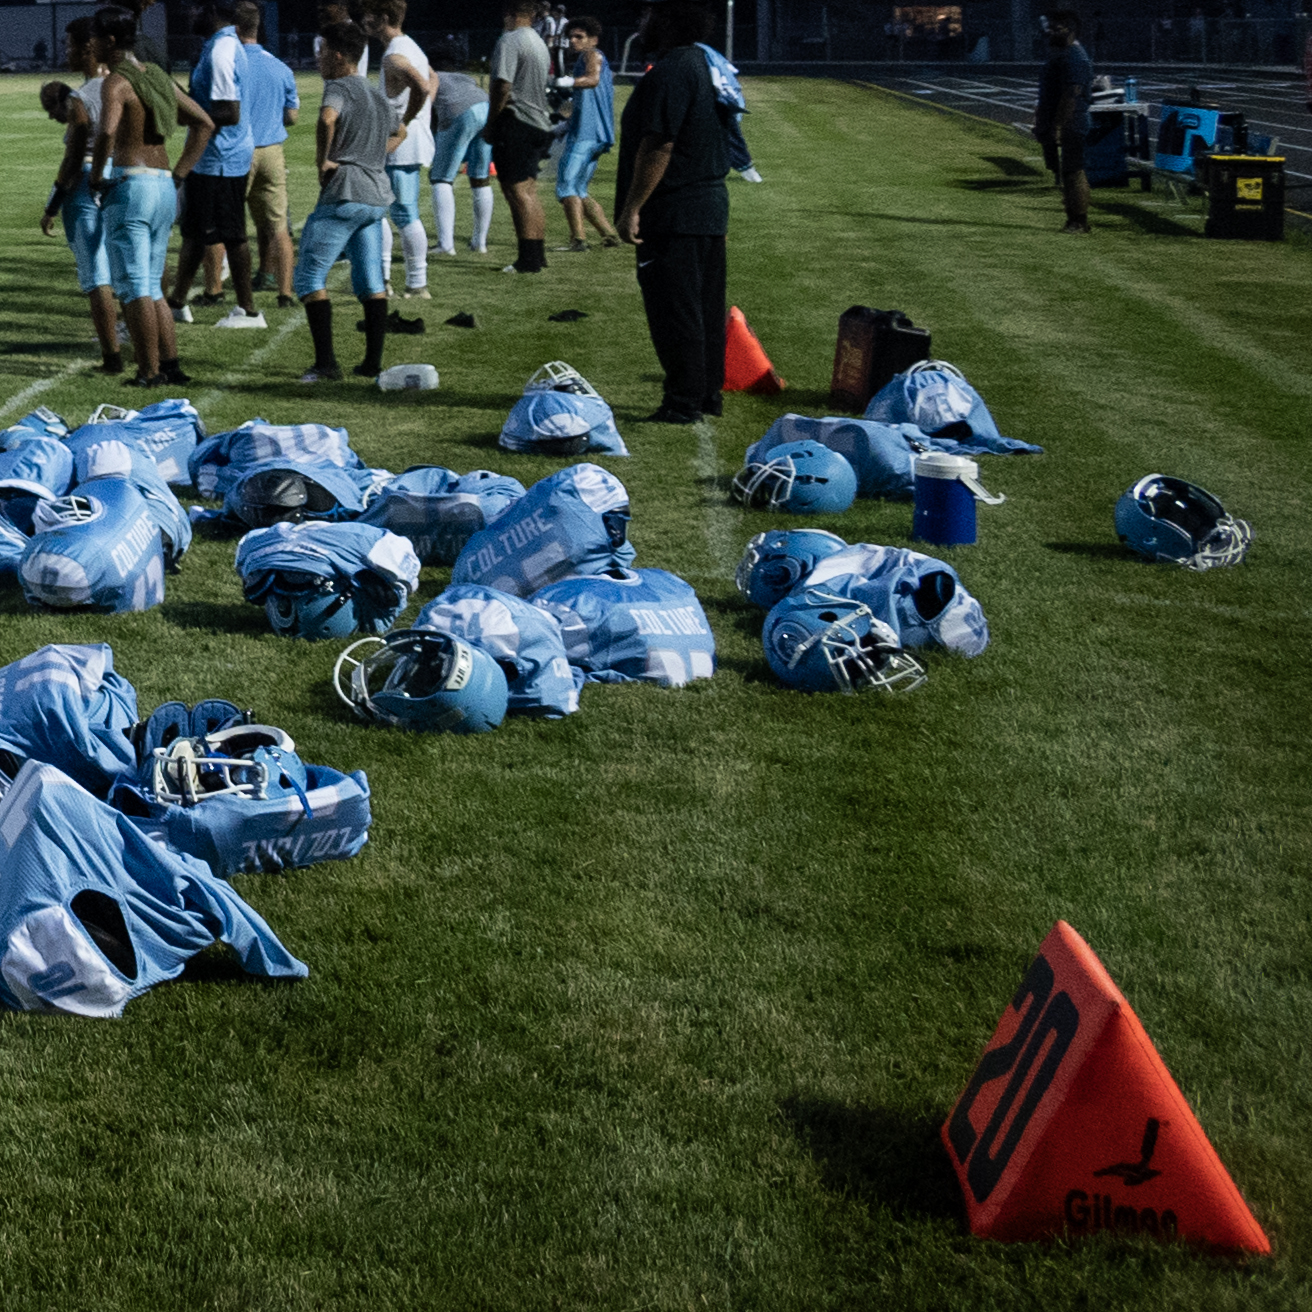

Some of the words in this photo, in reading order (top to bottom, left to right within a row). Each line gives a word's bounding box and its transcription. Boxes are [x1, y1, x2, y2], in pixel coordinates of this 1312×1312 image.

[111, 509, 160, 579] COLTURE
[467, 507, 554, 581] COLTURE
[629, 605, 708, 636] COLTURE
[948, 953, 1080, 1204] 20
